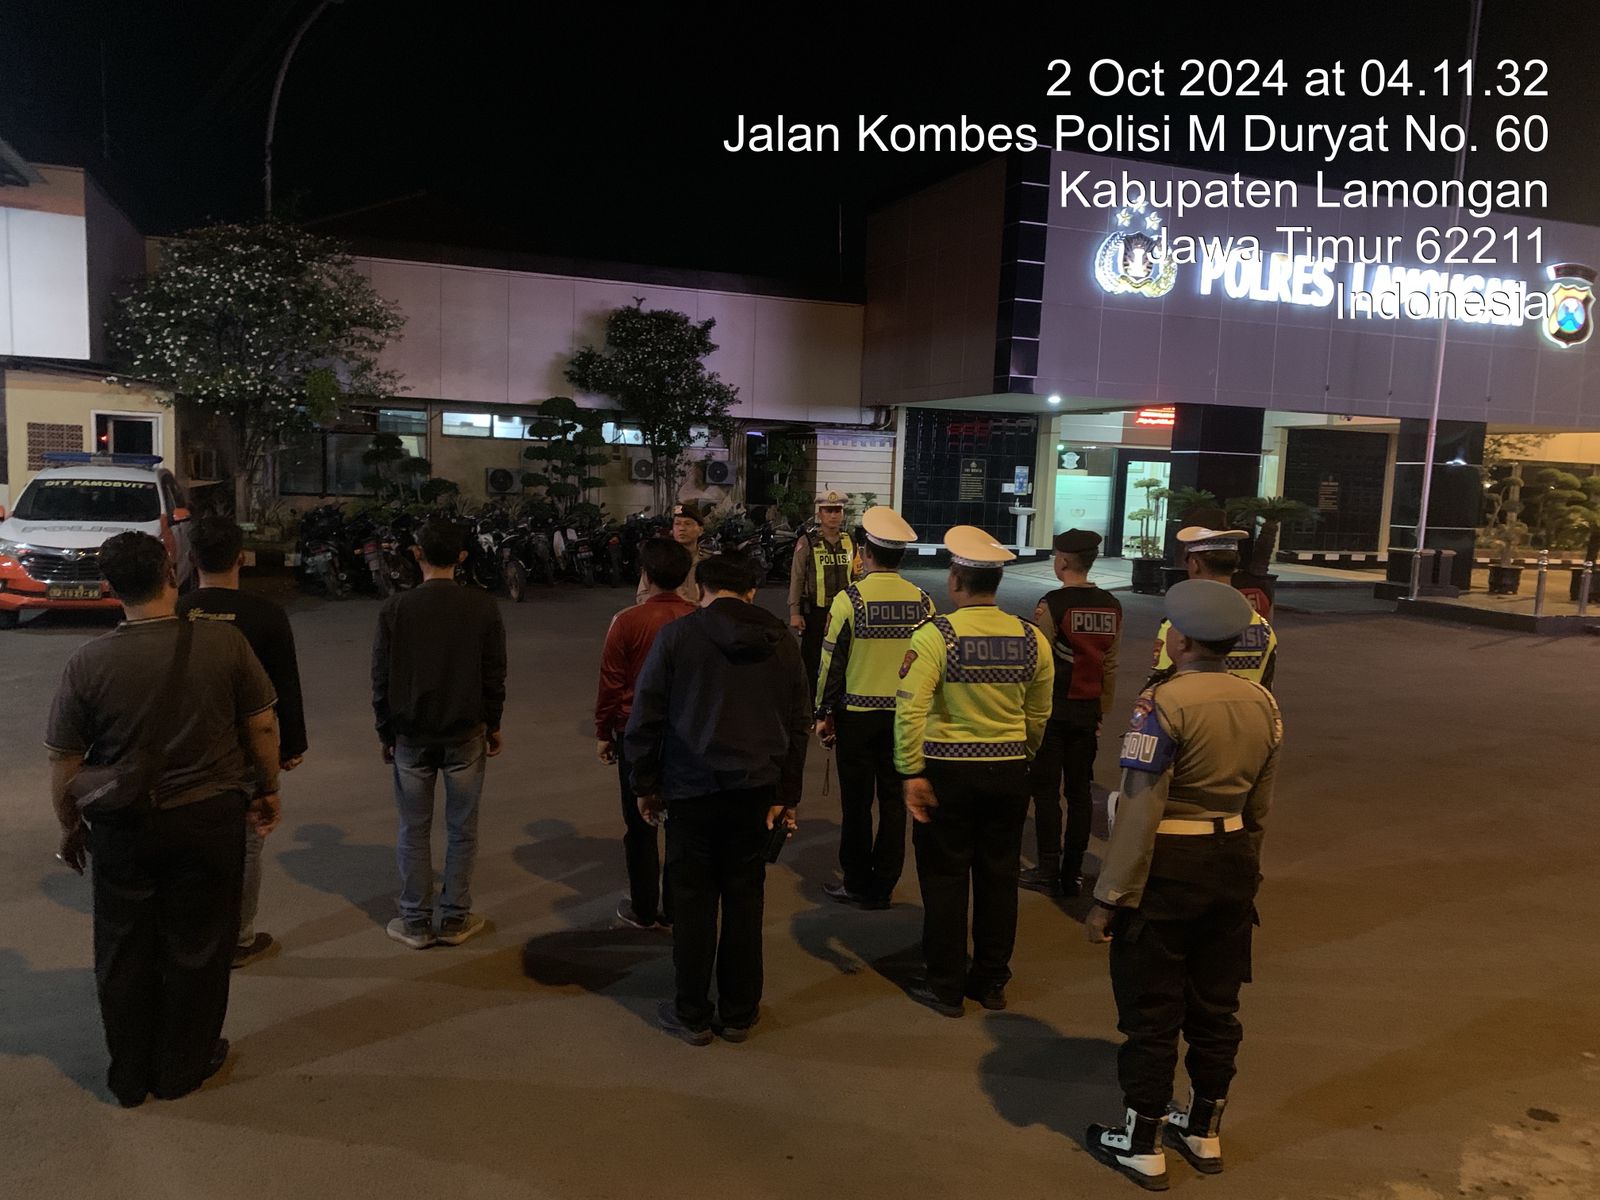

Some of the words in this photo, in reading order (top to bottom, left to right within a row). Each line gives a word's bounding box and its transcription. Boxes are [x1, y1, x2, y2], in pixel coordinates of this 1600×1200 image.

[1199, 246, 1336, 308] POLRES
[44, 479, 69, 487] DIT
[869, 604, 921, 621] POLISI
[1073, 612, 1117, 634] POLISI
[963, 639, 1025, 662] POLISI
